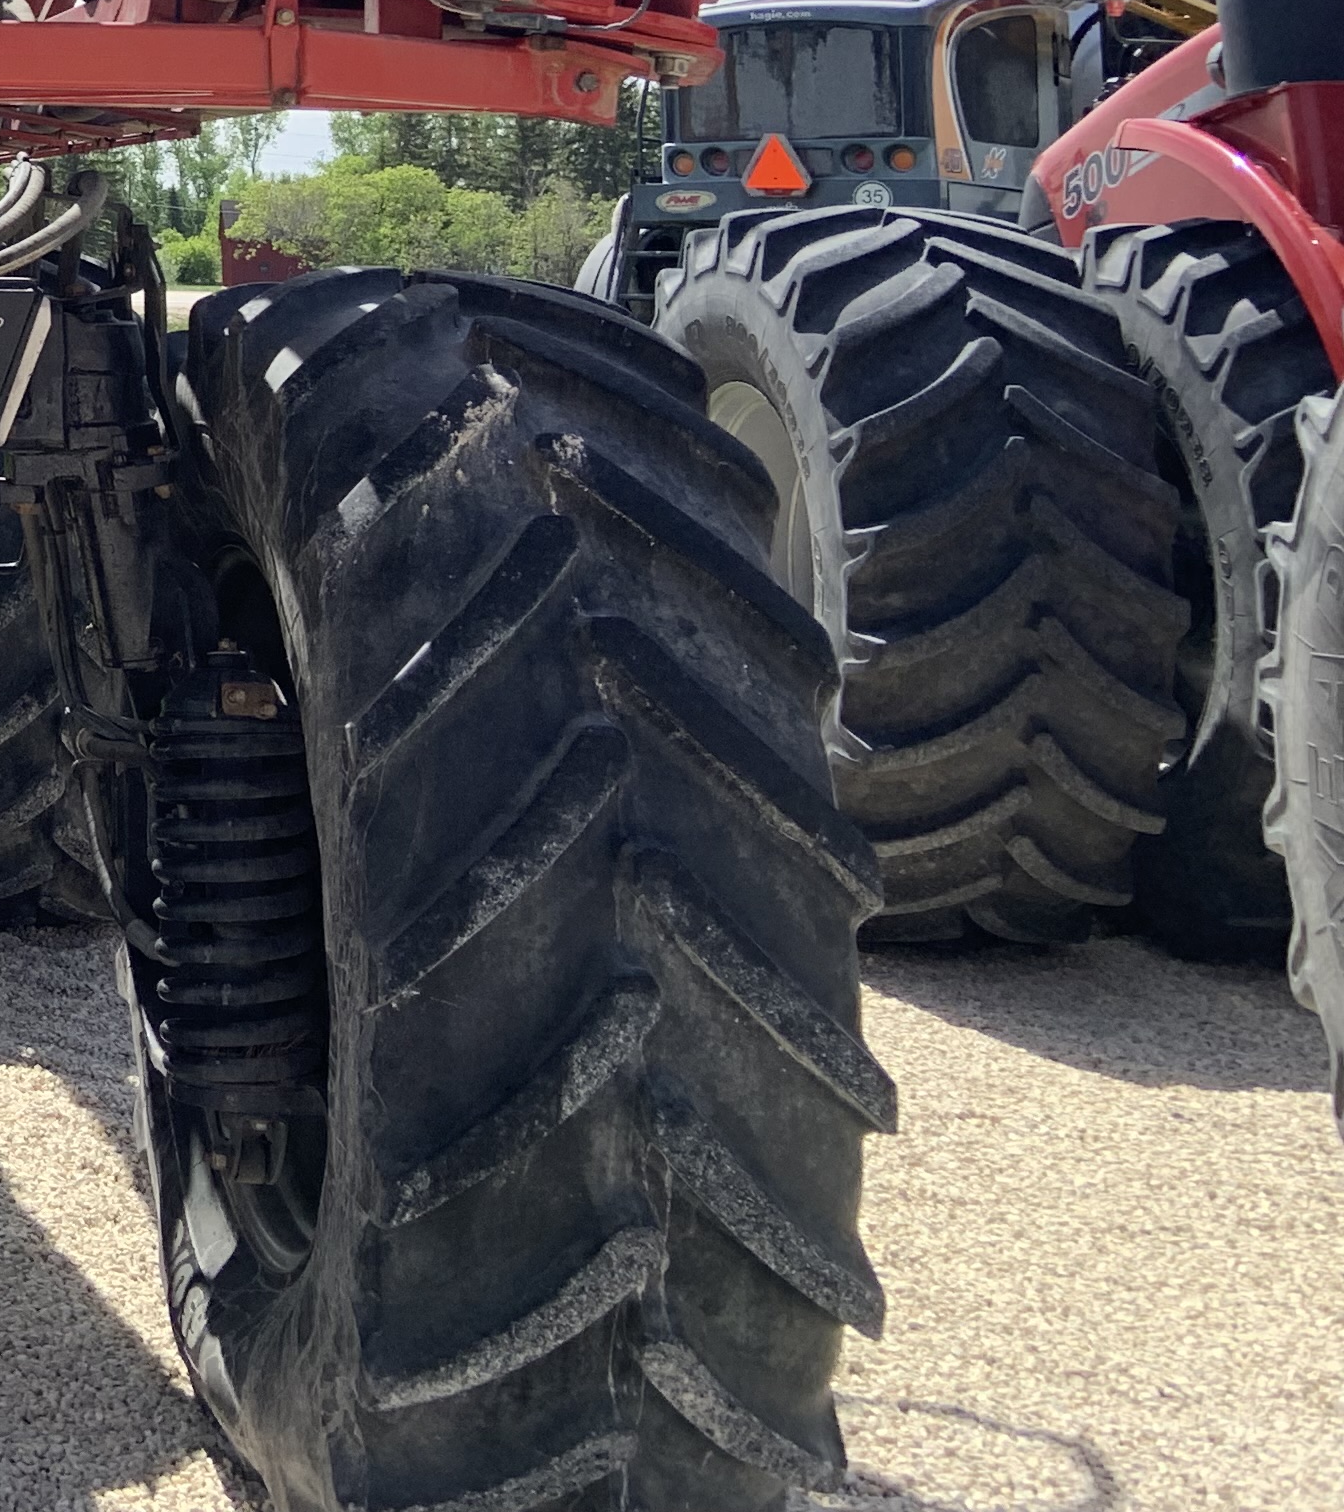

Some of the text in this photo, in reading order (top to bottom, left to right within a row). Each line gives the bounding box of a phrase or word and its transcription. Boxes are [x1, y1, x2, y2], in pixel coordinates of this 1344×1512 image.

[749, 9, 812, 21] hagie.com
[1062, 142, 1129, 219] 500
[861, 188, 883, 204] 35
